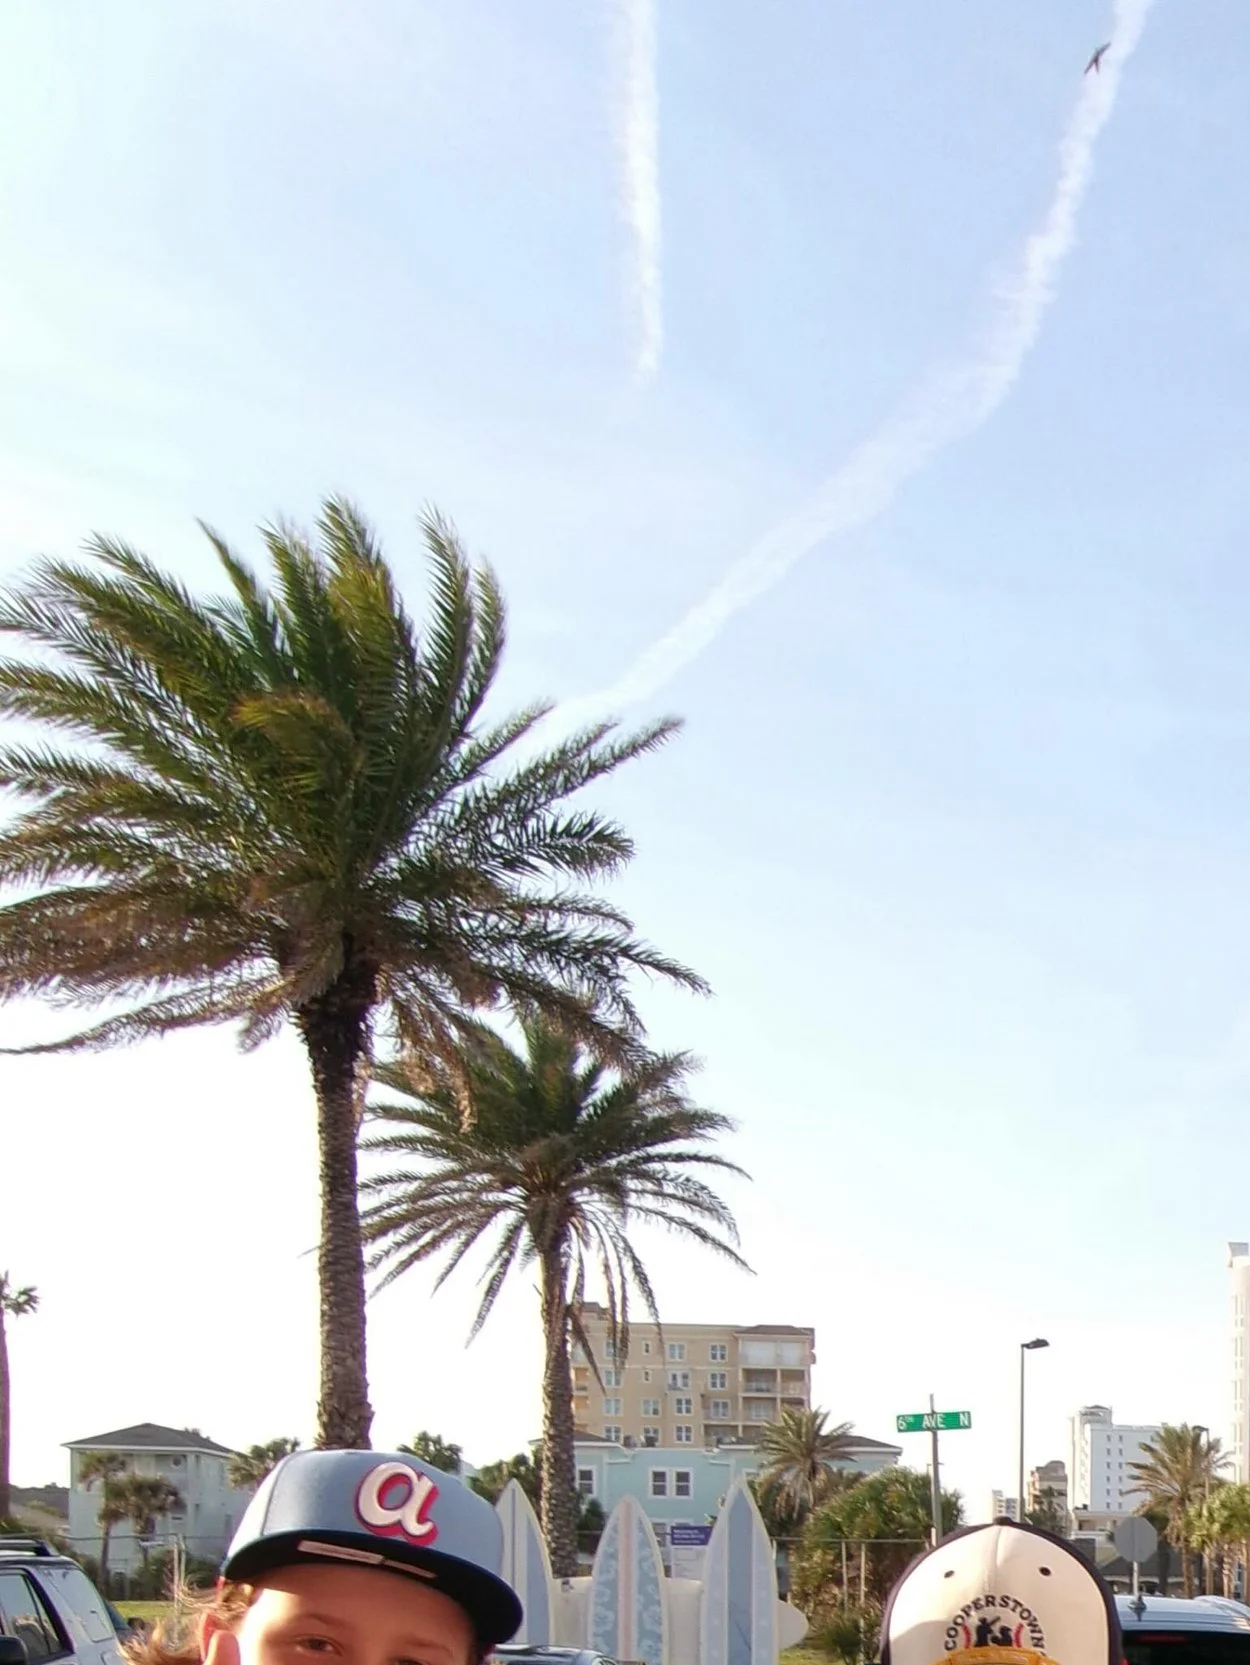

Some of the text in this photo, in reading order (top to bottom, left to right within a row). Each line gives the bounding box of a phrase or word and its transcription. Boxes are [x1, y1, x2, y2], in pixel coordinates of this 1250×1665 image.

[922, 1413, 947, 1429] AVE
[959, 1411, 970, 1427] N
[944, 1594, 1046, 1652] COOPERSTOWN
